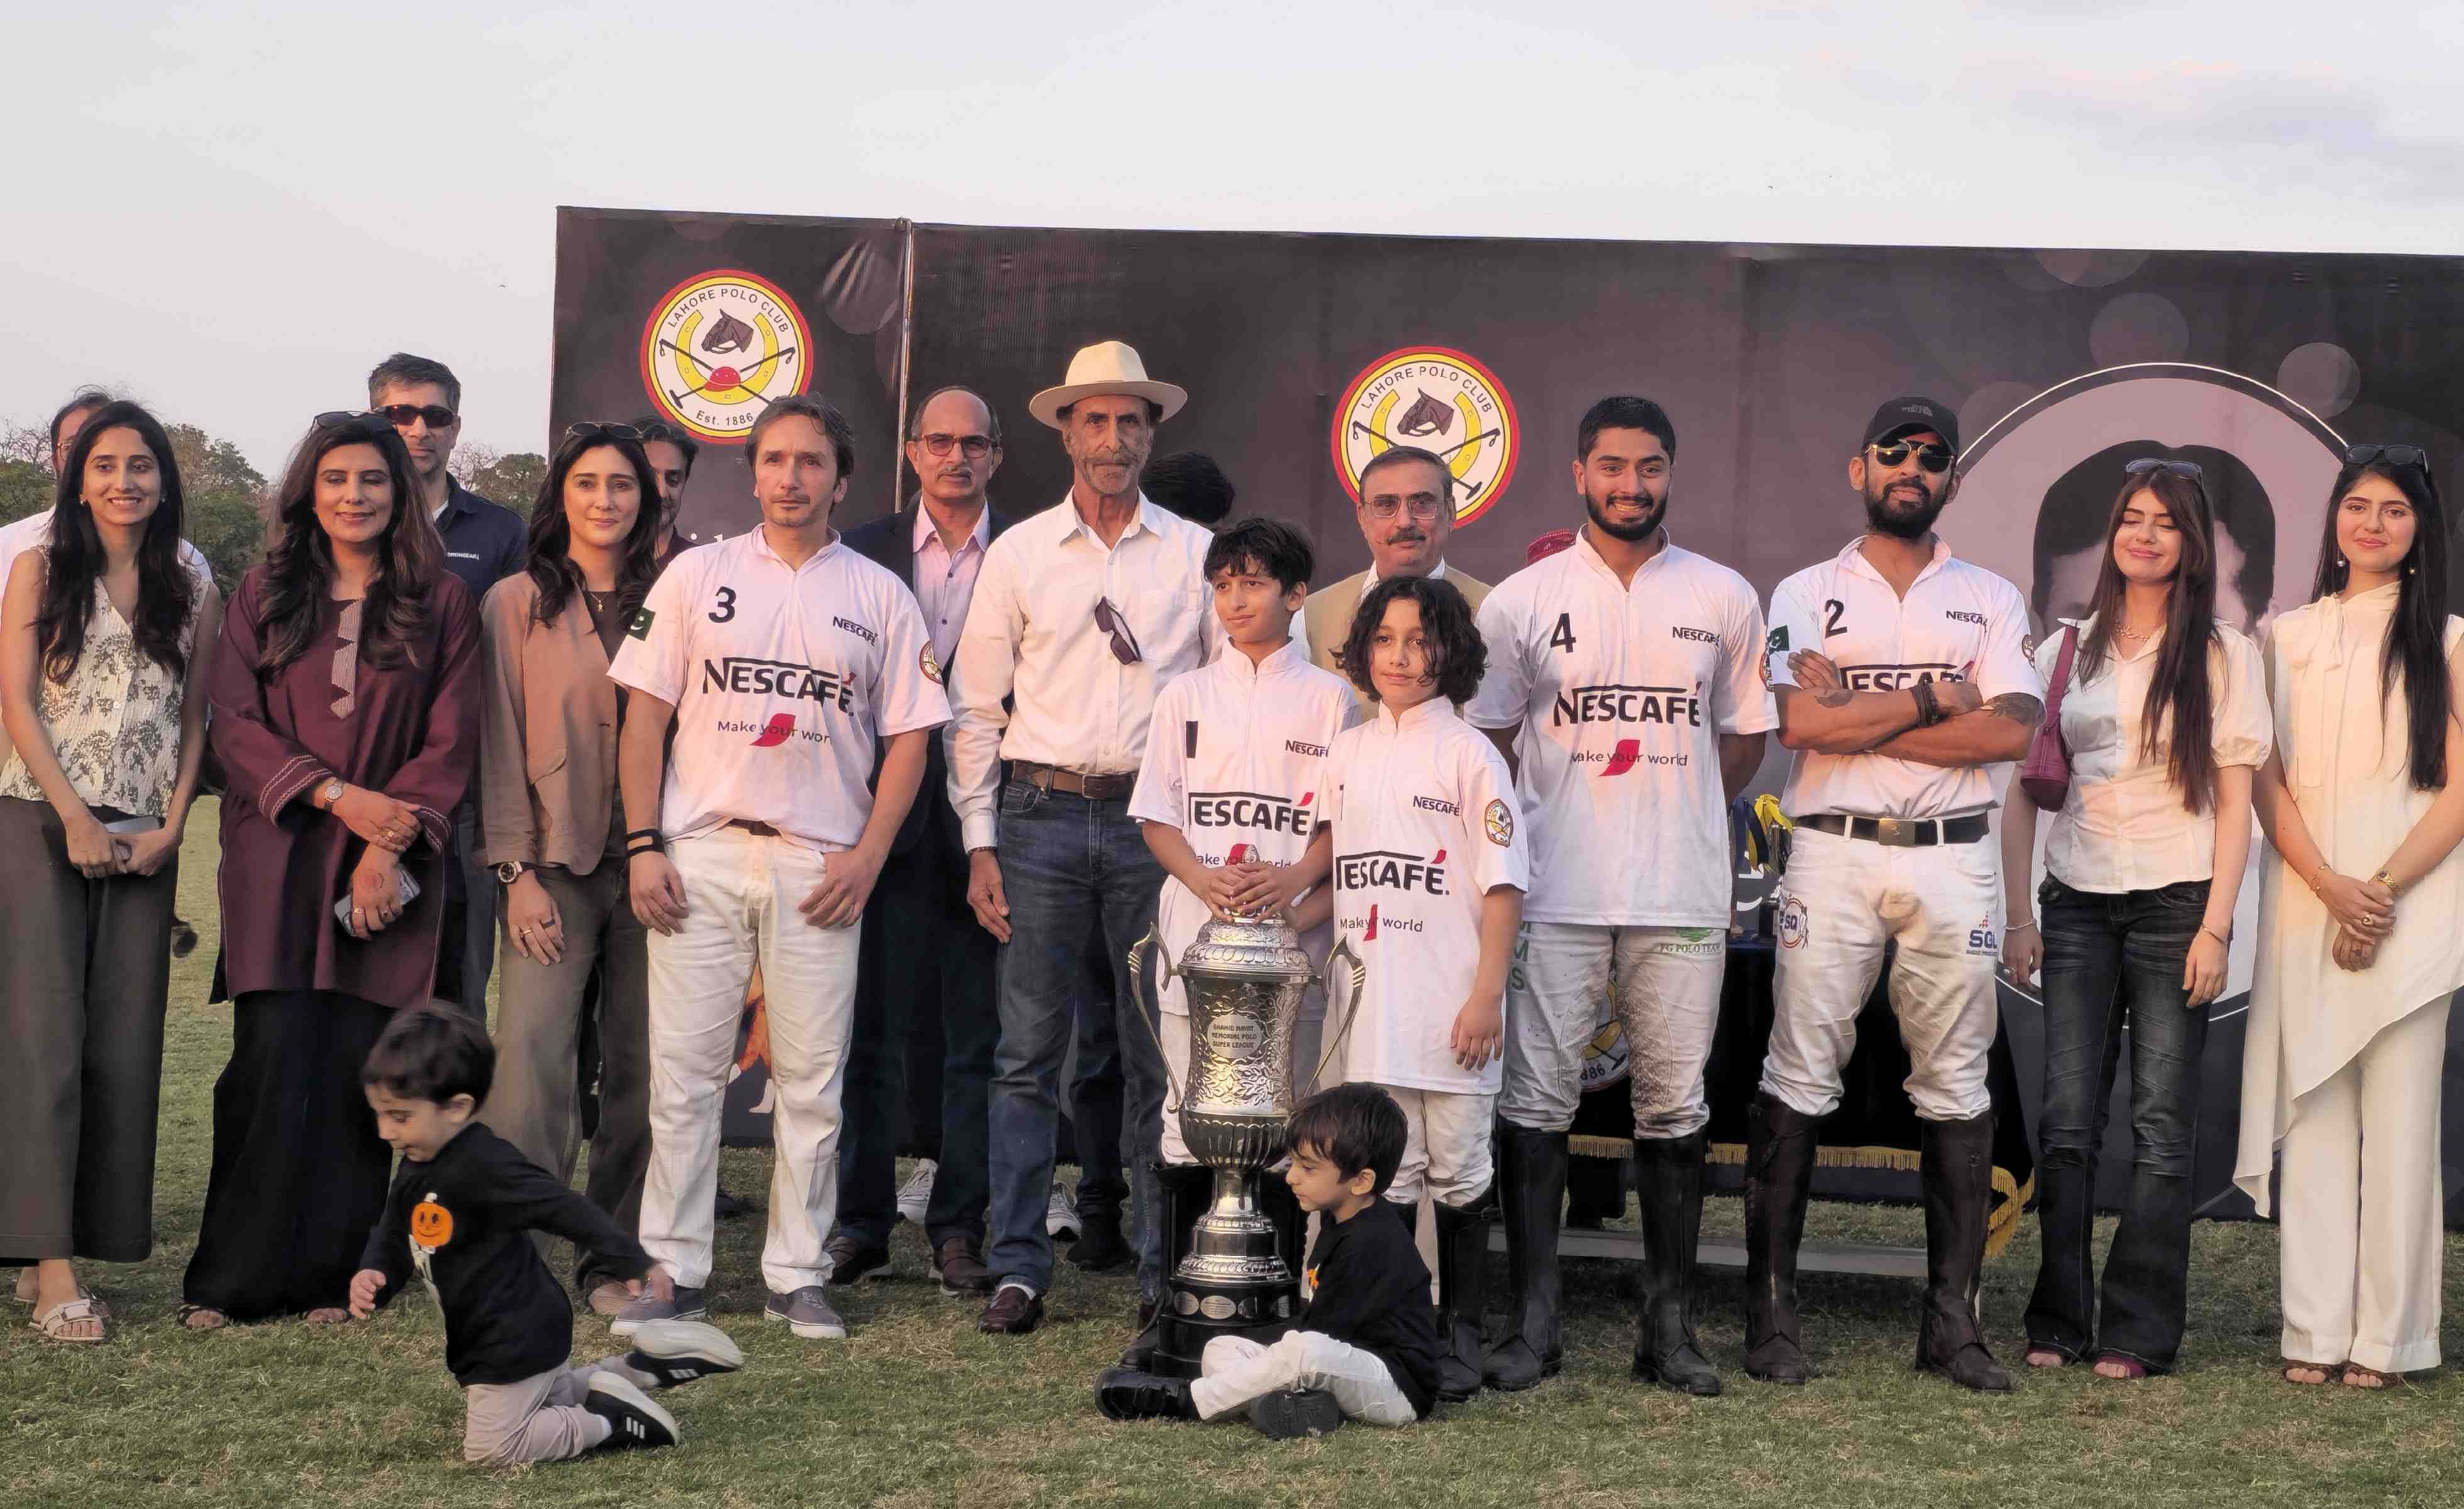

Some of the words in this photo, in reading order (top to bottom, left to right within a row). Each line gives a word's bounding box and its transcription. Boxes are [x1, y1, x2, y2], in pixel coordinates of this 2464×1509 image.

[668, 288, 716, 328] LAHORE
[720, 288, 758, 304] POLO
[761, 301, 789, 333] CLUB
[1361, 367, 1414, 409] LAHORE
[1419, 365, 1459, 382] POLO
[1462, 379, 1493, 413] CLUB
[696, 409, 720, 426] Est.
[725, 412, 754, 426] 1886
[708, 585, 737, 624] 3
[1824, 598, 1848, 639] 2
[1549, 612, 1576, 654] 4
[717, 721, 757, 732] Make
[760, 722, 798, 736] your
[1285, 739, 1329, 758] NESCAF
[1570, 749, 1603, 765] Make
[1607, 752, 1643, 765] your
[1647, 752, 1688, 766] world
[1412, 795, 1461, 817] NESCAFÉ
[1382, 917, 1424, 932] world
[1675, 943, 1701, 954] POLO
